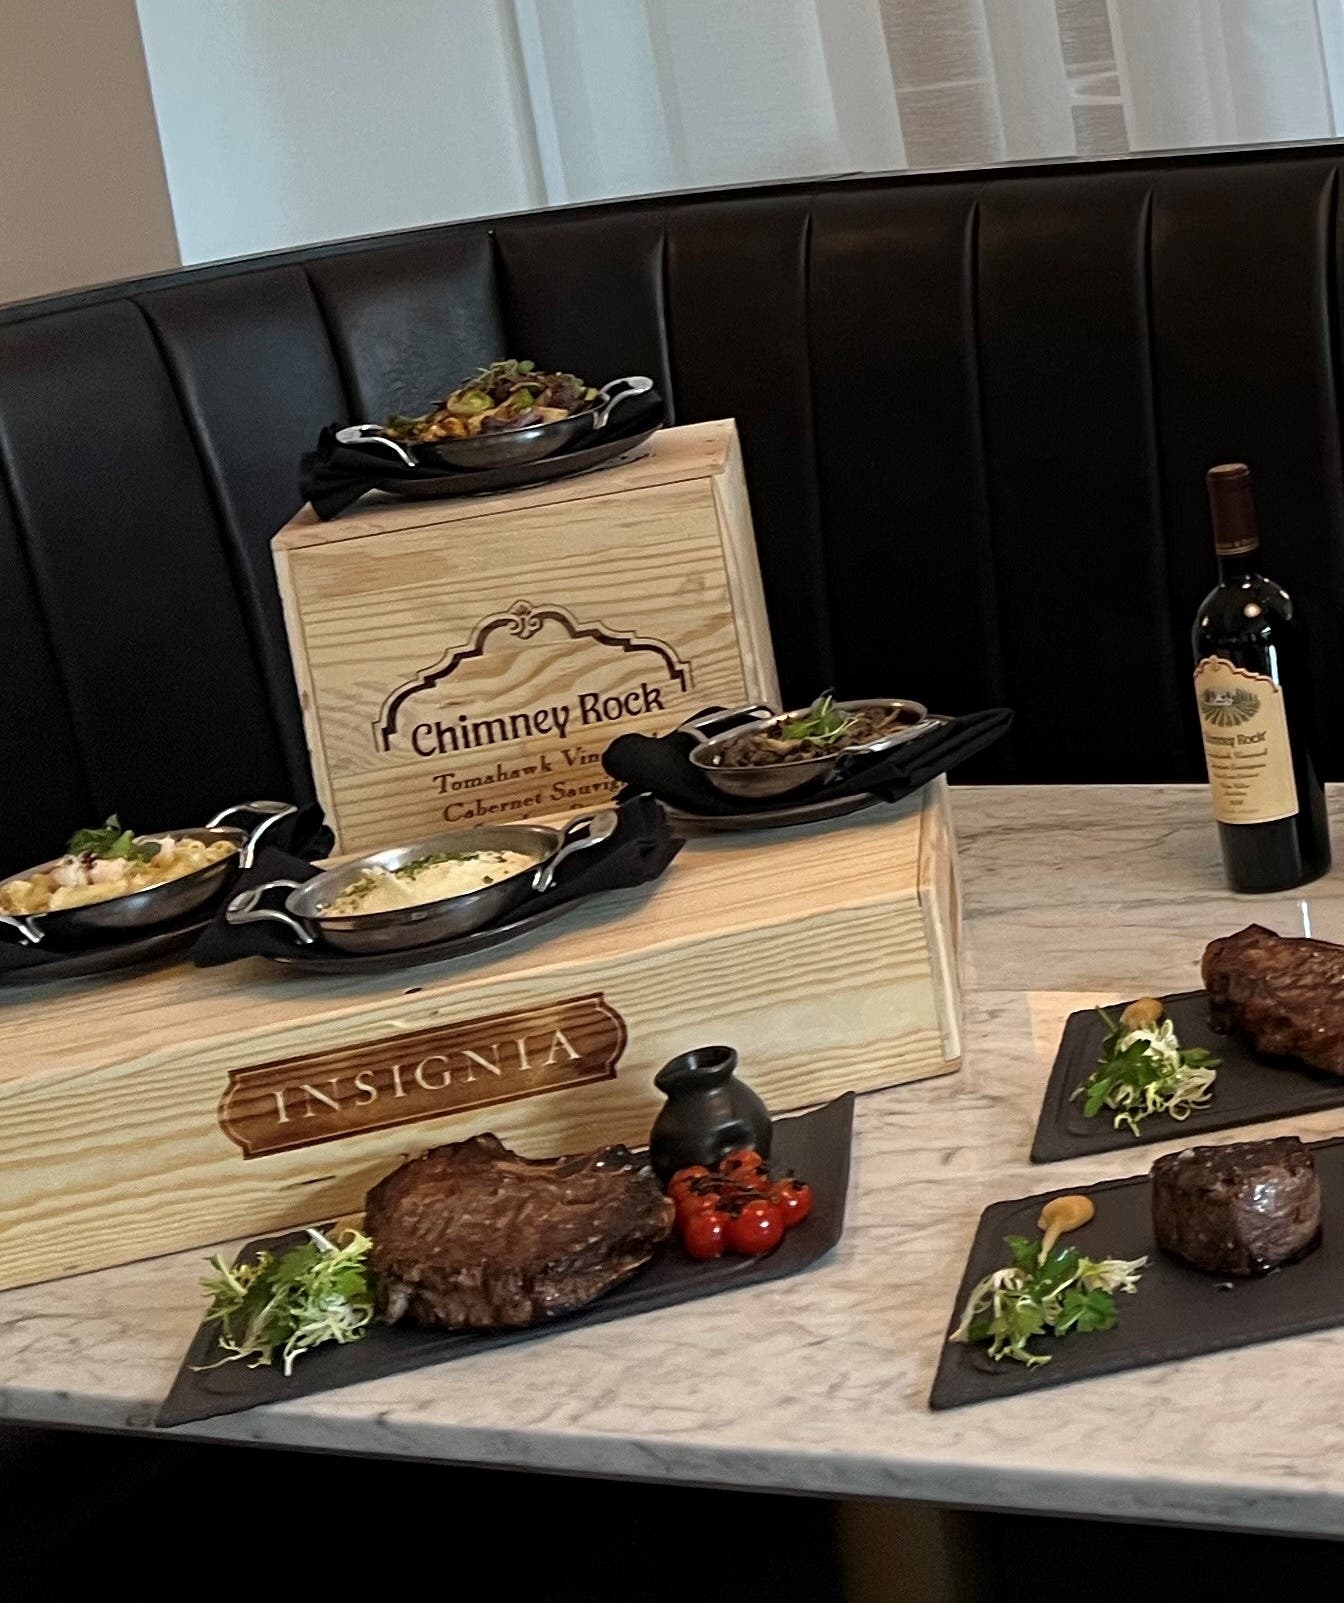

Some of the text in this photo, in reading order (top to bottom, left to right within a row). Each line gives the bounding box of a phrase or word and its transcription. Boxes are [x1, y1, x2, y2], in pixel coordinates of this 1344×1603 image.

[412, 706, 570, 757] Chimney
[579, 683, 665, 725] Rock
[433, 755, 553, 795] Tomahawk
[444, 793, 543, 823] Cabernet
[272, 1029, 583, 1124] INSIGNIA
